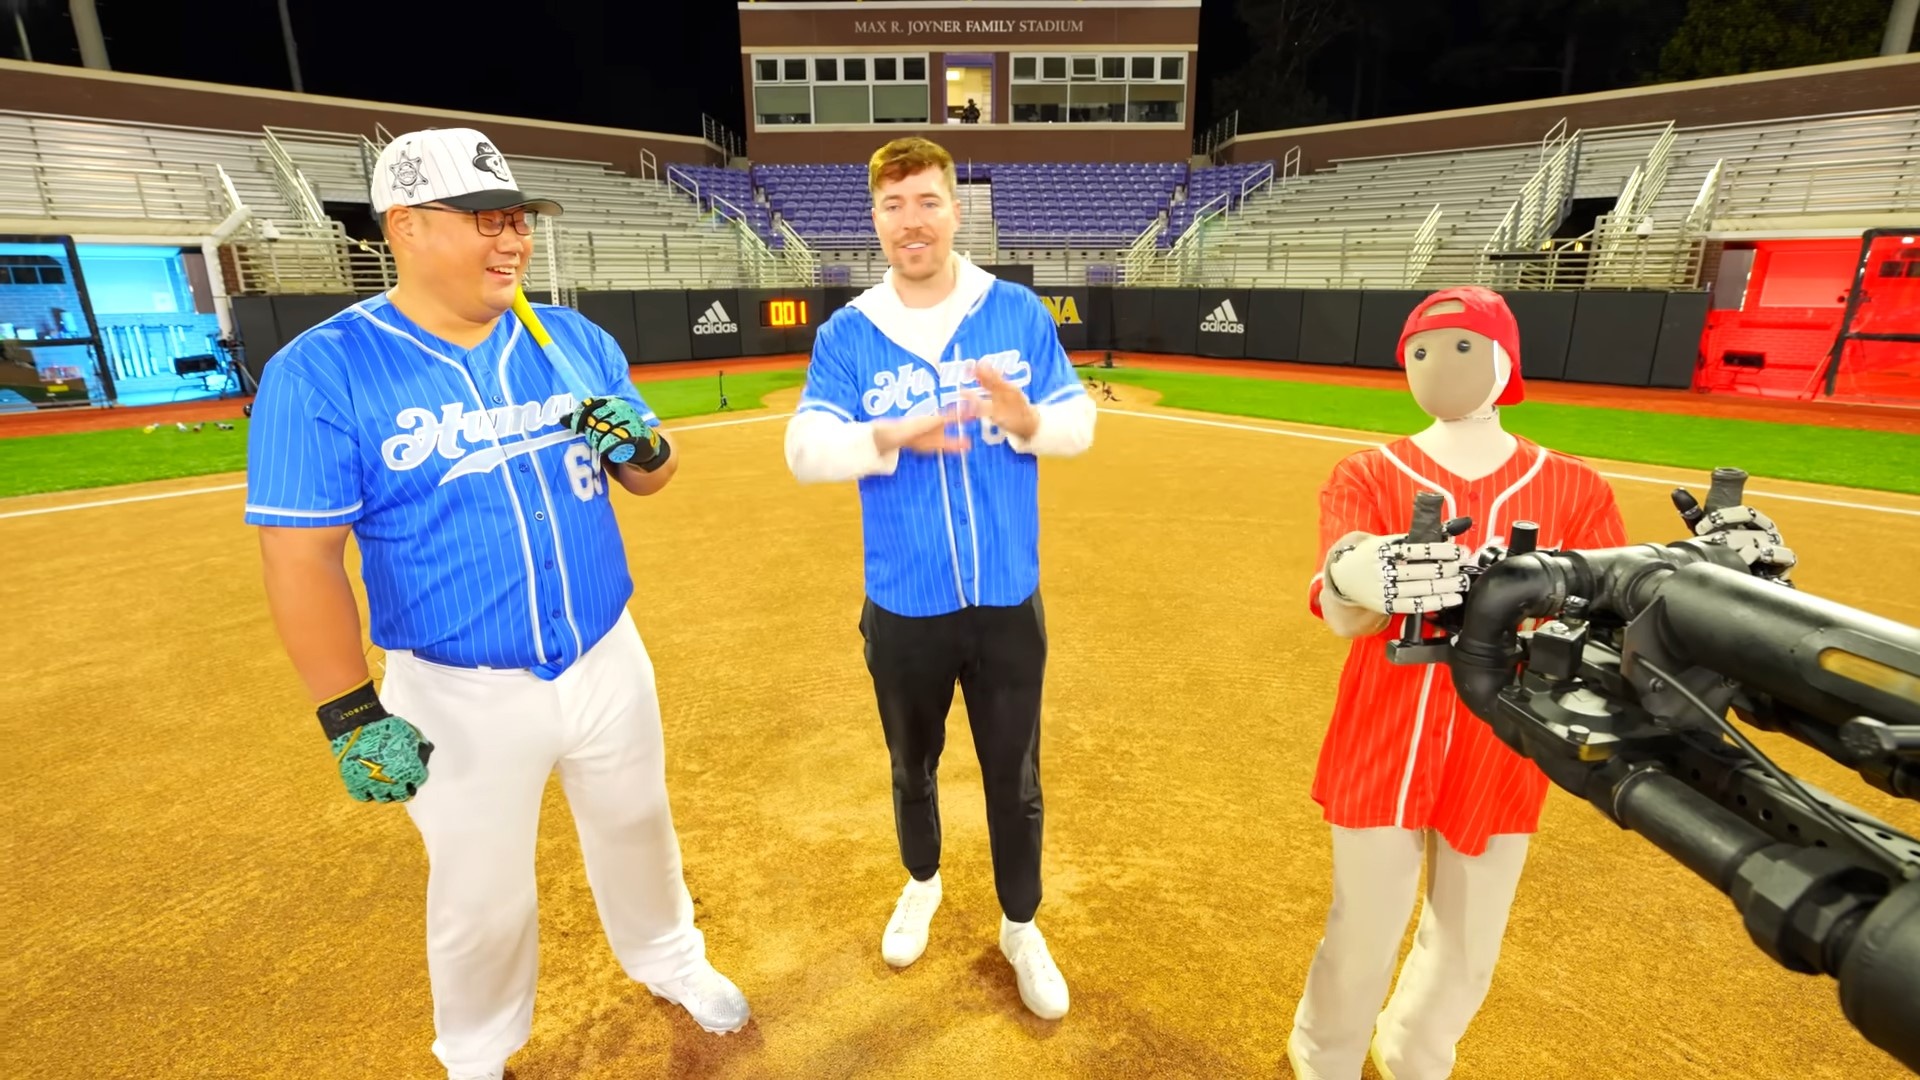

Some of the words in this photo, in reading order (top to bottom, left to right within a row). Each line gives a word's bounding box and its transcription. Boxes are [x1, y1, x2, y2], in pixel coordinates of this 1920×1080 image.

[854, 21, 887, 34] MAX
[891, 21, 904, 34] R.
[907, 20, 962, 36] JOYNER
[965, 20, 1016, 33] FAMILY
[1019, 20, 1084, 33] STADIUM
[770, 301, 807, 326] 001
[693, 321, 738, 335] adidas
[1200, 319, 1245, 334] adidas
[381, 392, 577, 471] Huma
